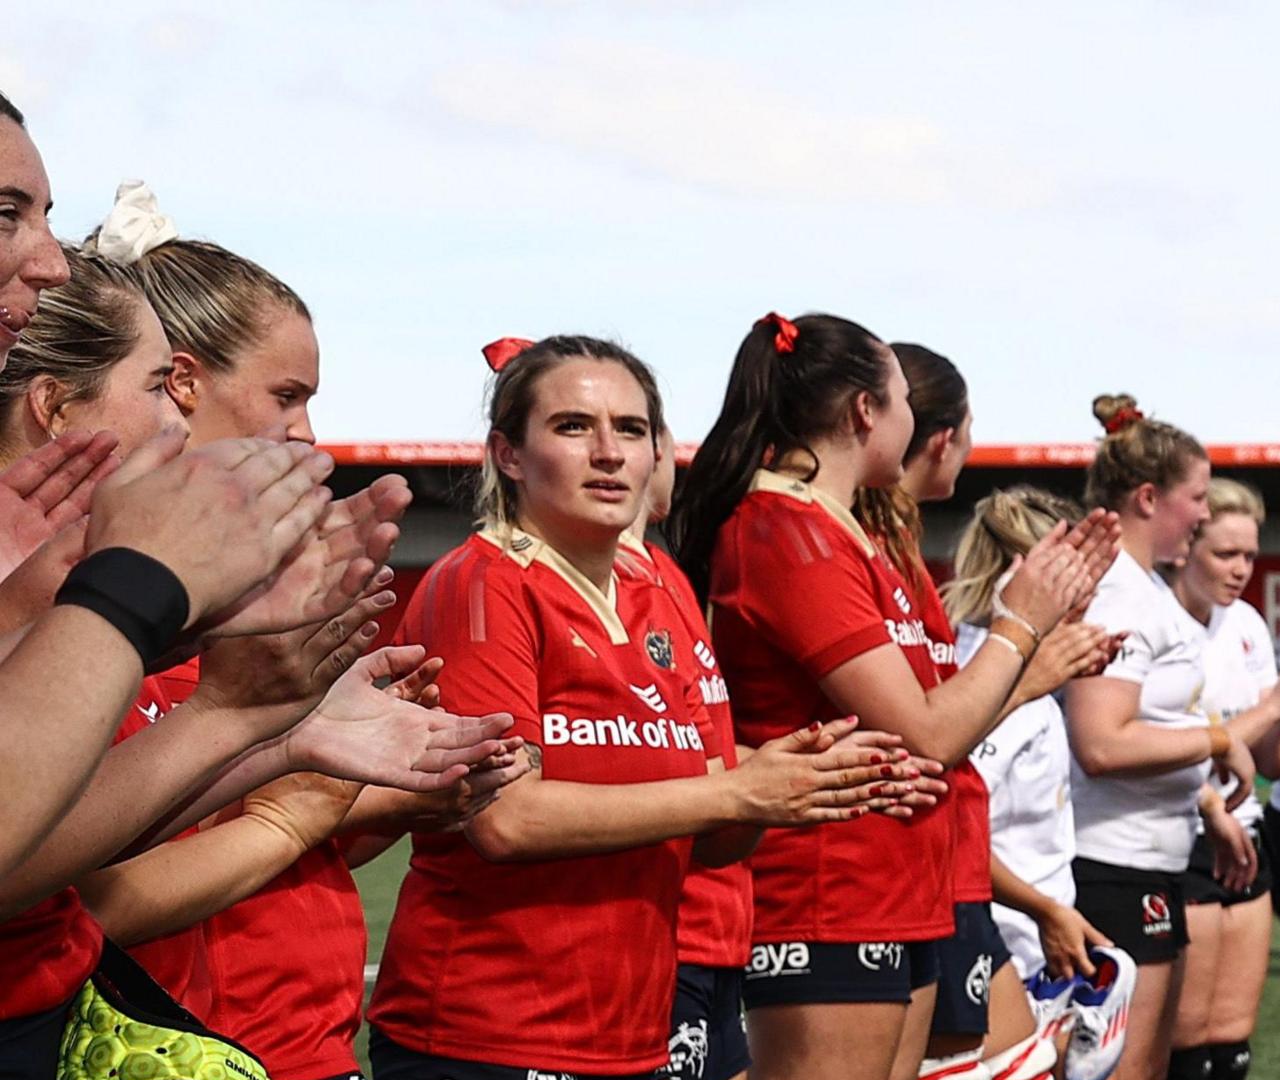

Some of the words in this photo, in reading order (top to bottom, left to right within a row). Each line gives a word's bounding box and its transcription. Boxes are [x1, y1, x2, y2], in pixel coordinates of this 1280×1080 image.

[543, 713, 643, 747] Bank
[643, 718, 669, 749] of
[745, 942, 810, 976] aya
